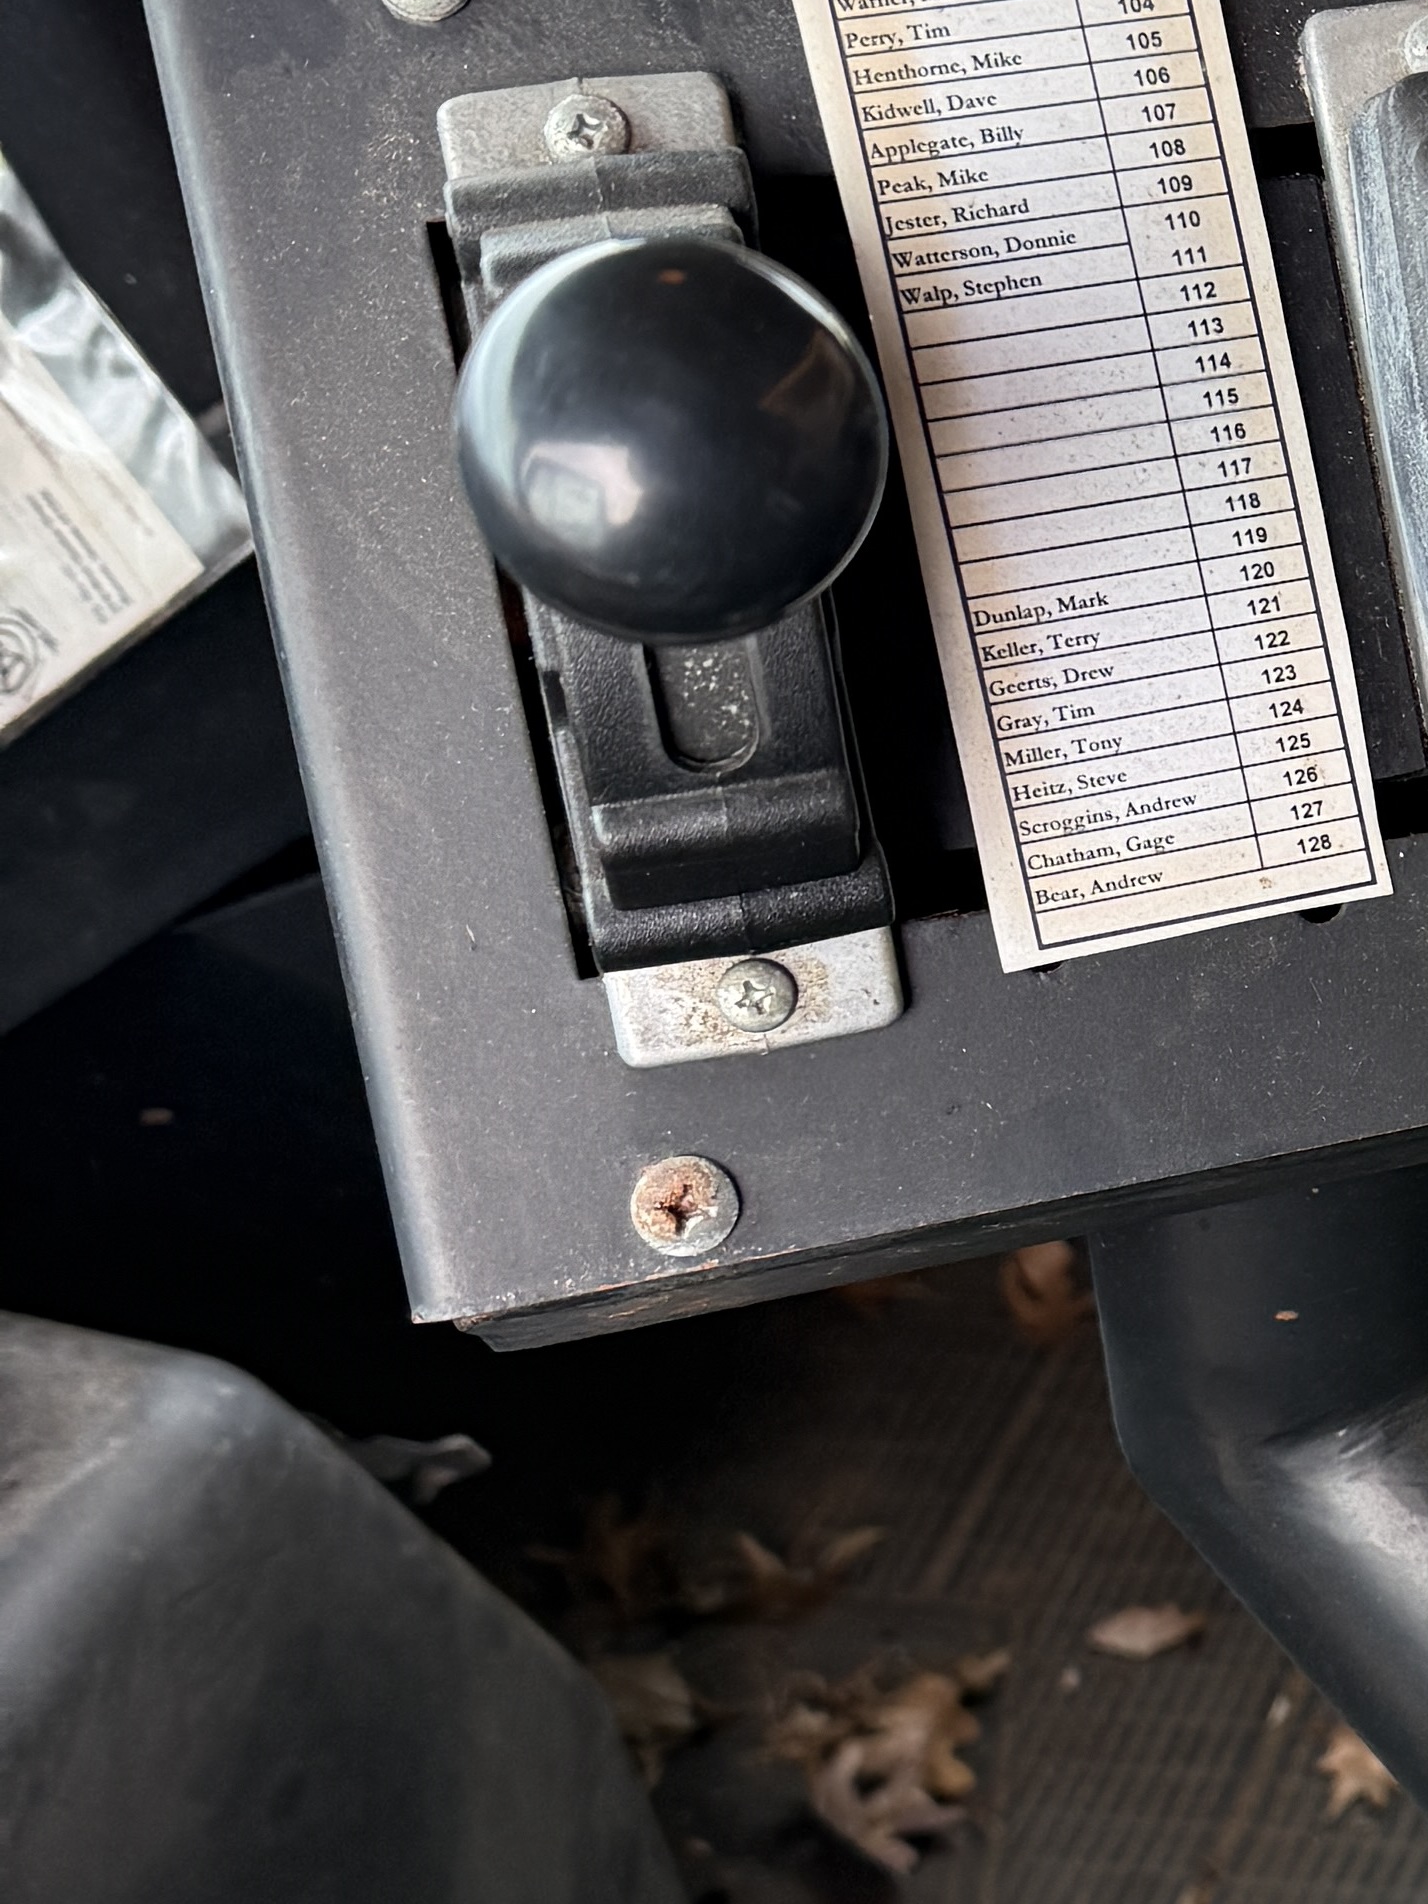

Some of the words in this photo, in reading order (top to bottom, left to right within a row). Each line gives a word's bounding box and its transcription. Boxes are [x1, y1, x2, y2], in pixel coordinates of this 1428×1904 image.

[845, 28, 904, 49] Perry,
[907, 23, 951, 41] Tim
[1126, 32, 1162, 50] 105
[972, 51, 1022, 69] Mike
[1134, 67, 1170, 87] 106
[862, 101, 942, 123] Kidwell,
[947, 93, 997, 111] Dave
[1142, 104, 1176, 123] 107
[871, 133, 974, 163] Applegate,
[980, 125, 1025, 146] Billy
[1150, 139, 1186, 158] 108
[877, 176, 932, 196] Peak,
[939, 168, 988, 186] Mike
[1157, 175, 1193, 195] 109
[884, 212, 946, 236] Jester,
[953, 198, 1029, 220] Richard
[1165, 211, 1200, 230] 110
[893, 244, 998, 269] Watterson,
[1005, 229, 1077, 253] Donnie
[1172, 247, 1207, 265] 111
[901, 286, 958, 305] Walp,
[963, 273, 1042, 300] Stephen
[1181, 282, 1216, 301] 112
[1188, 318, 1224, 336] 113
[1195, 353, 1231, 374] 114
[1203, 388, 1239, 408] 115
[1210, 422, 1246, 442] 116
[1218, 458, 1252, 478] 117
[1226, 492, 1260, 512] 118
[1232, 526, 1268, 546] 119
[1240, 561, 1274, 581] 120
[973, 604, 1052, 628] Dunlap,
[1058, 590, 1109, 612] Mark
[1247, 595, 1281, 616] 121
[980, 640, 1044, 663] Keller,
[1047, 629, 1100, 651] Terry
[1254, 630, 1290, 650] 122
[1063, 664, 1114, 684] Drew
[1261, 664, 1296, 684] 123
[997, 712, 1050, 734] Gray,
[1052, 702, 1094, 722] Tim
[1269, 698, 1304, 718] 124
[1004, 746, 1066, 768] Miller,
[1070, 734, 1122, 758] Tony
[1276, 732, 1311, 752] 125
[1012, 779, 1074, 802] Heitz,
[1078, 769, 1128, 790] Steve
[1282, 766, 1318, 786] 126
[1019, 808, 1120, 837] Scroggins,
[1124, 792, 1196, 819] Andrew
[1290, 800, 1324, 821] 127
[1028, 846, 1120, 871] Chatham,
[1126, 831, 1175, 857] Gage
[1296, 834, 1332, 854] 128
[1036, 885, 1086, 905] Bear,
[1092, 870, 1162, 894] Andrew
